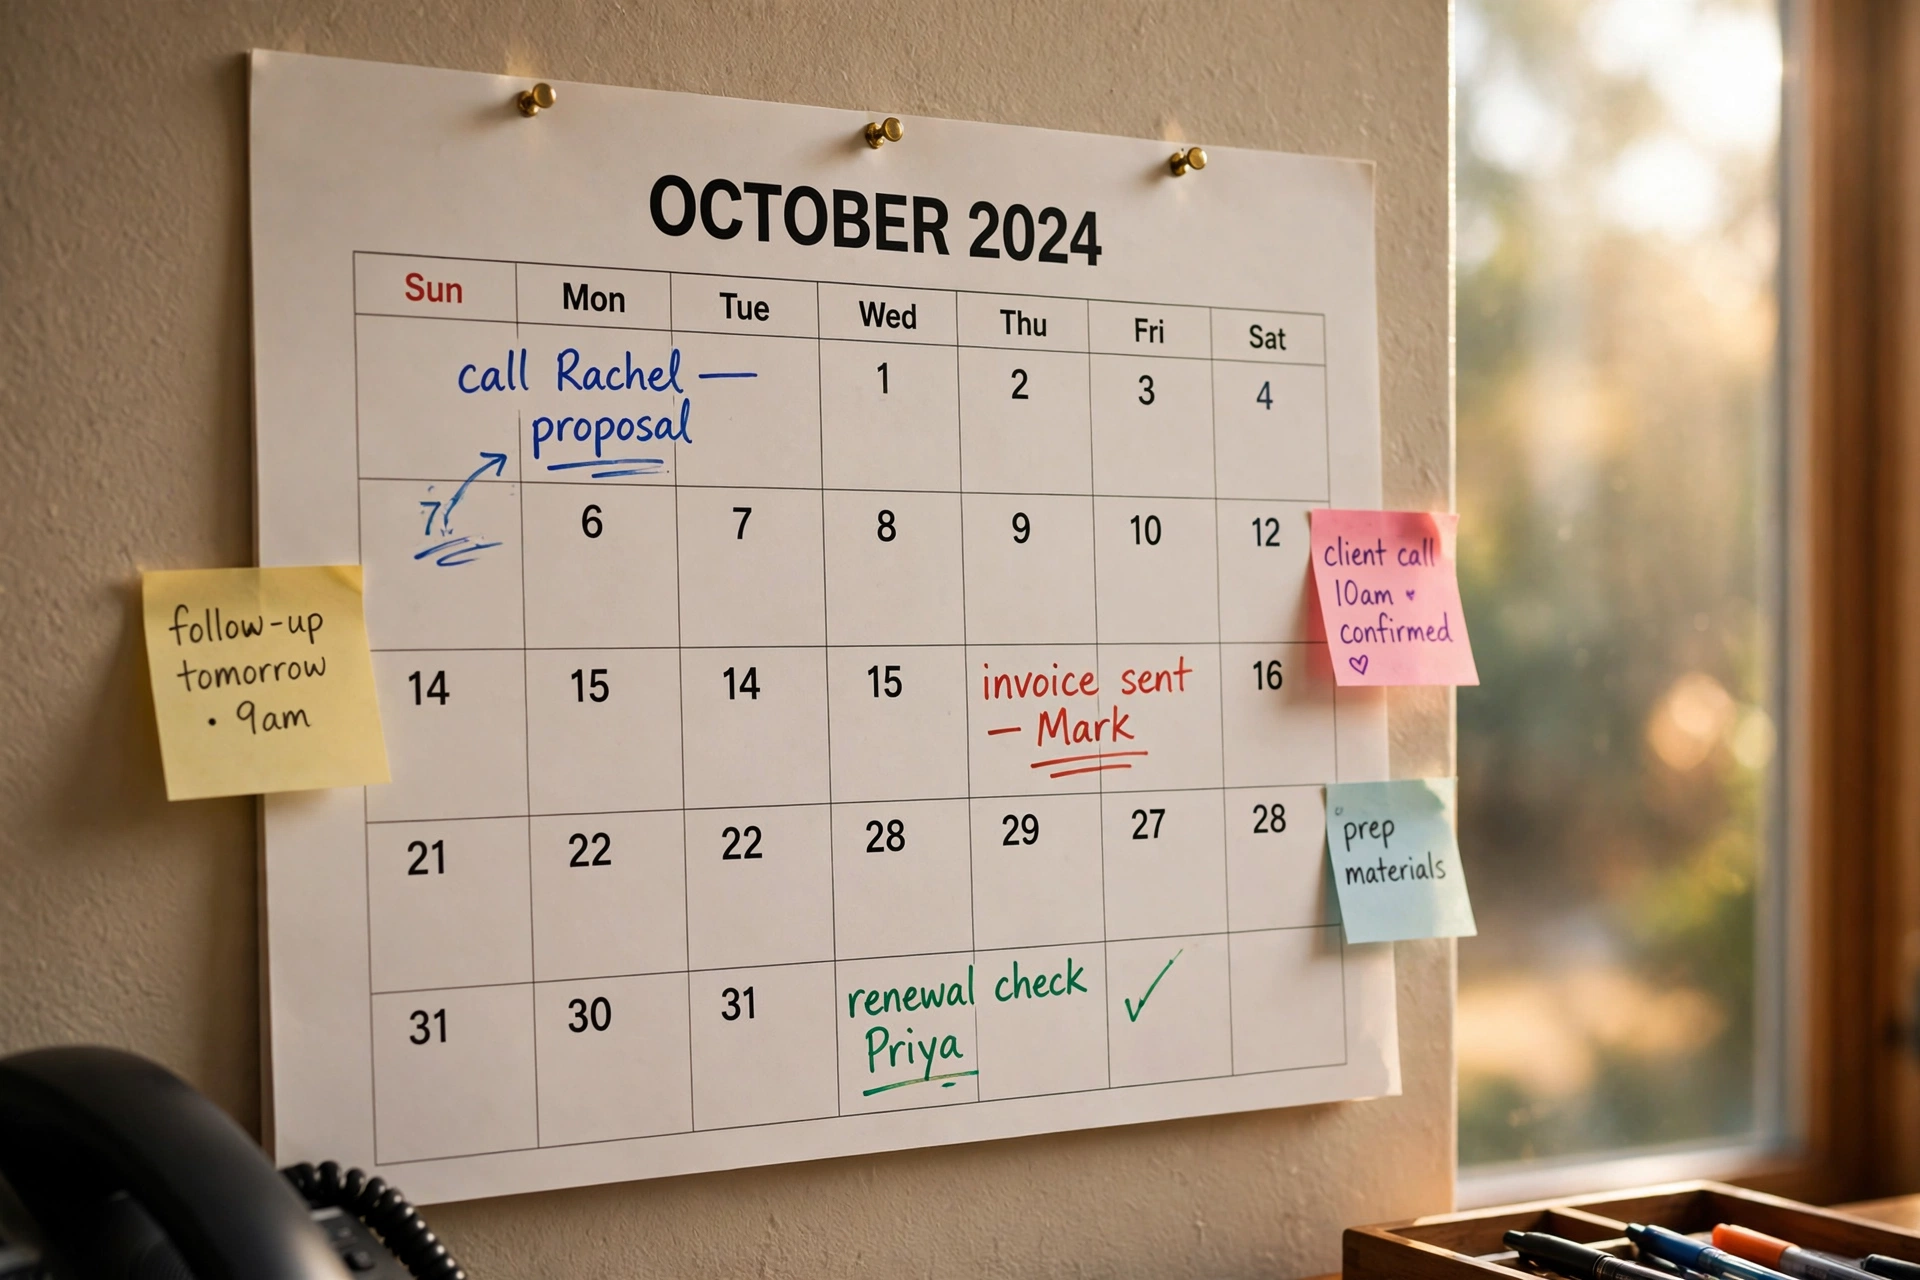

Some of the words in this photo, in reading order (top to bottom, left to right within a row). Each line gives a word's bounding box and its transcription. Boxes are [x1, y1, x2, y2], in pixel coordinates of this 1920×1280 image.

[649, 174, 950, 256] OCTOBER
[968, 200, 1103, 267] 2024
[405, 272, 463, 304] Sun
[562, 282, 625, 313] Mon
[719, 291, 770, 322] Tue
[858, 300, 917, 330] Wed
[999, 308, 1047, 337] Thu
[1134, 317, 1164, 344] Fri
[1248, 324, 1288, 352] Sat
[458, 347, 529, 394] call
[556, 347, 684, 394] Rachel
[877, 362, 888, 394] 1
[1011, 368, 1029, 400] 2
[1138, 374, 1155, 406] 3
[1256, 380, 1274, 411] 4
[531, 397, 693, 459] proposal
[581, 504, 603, 539] 6
[732, 506, 752, 540] 7
[877, 509, 897, 543] 8
[1011, 511, 1031, 544] 9
[1130, 514, 1162, 546] 10
[1251, 517, 1281, 547] 12
[1324, 535, 1387, 567] client
[1396, 536, 1437, 567] call
[1335, 579, 1394, 607] 10am
[168, 603, 324, 646] follow-up
[1339, 611, 1453, 646] confirmed
[176, 656, 326, 692] tomorrow
[408, 670, 450, 706] 14
[571, 668, 610, 703] 15
[723, 666, 761, 700] 14
[867, 664, 903, 698] 15
[983, 662, 1100, 701] invoice
[1121, 655, 1193, 696] sent
[1253, 659, 1283, 691] 16
[236, 700, 311, 735] 9am
[1037, 704, 1135, 747] Mark
[407, 839, 445, 876] 21
[568, 831, 612, 868] 22
[721, 825, 763, 861] 22
[865, 818, 906, 854] 28
[1002, 813, 1040, 847] 29
[1131, 808, 1166, 840] 27
[1252, 803, 1287, 834] 28
[1343, 819, 1395, 852] prep
[1345, 851, 1446, 886] materials
[848, 964, 975, 1019] renewal
[994, 957, 1088, 1002] check
[409, 1008, 447, 1046] 31
[568, 996, 612, 1034] 30
[721, 986, 755, 1022] 31
[864, 1025, 964, 1080] Priya
